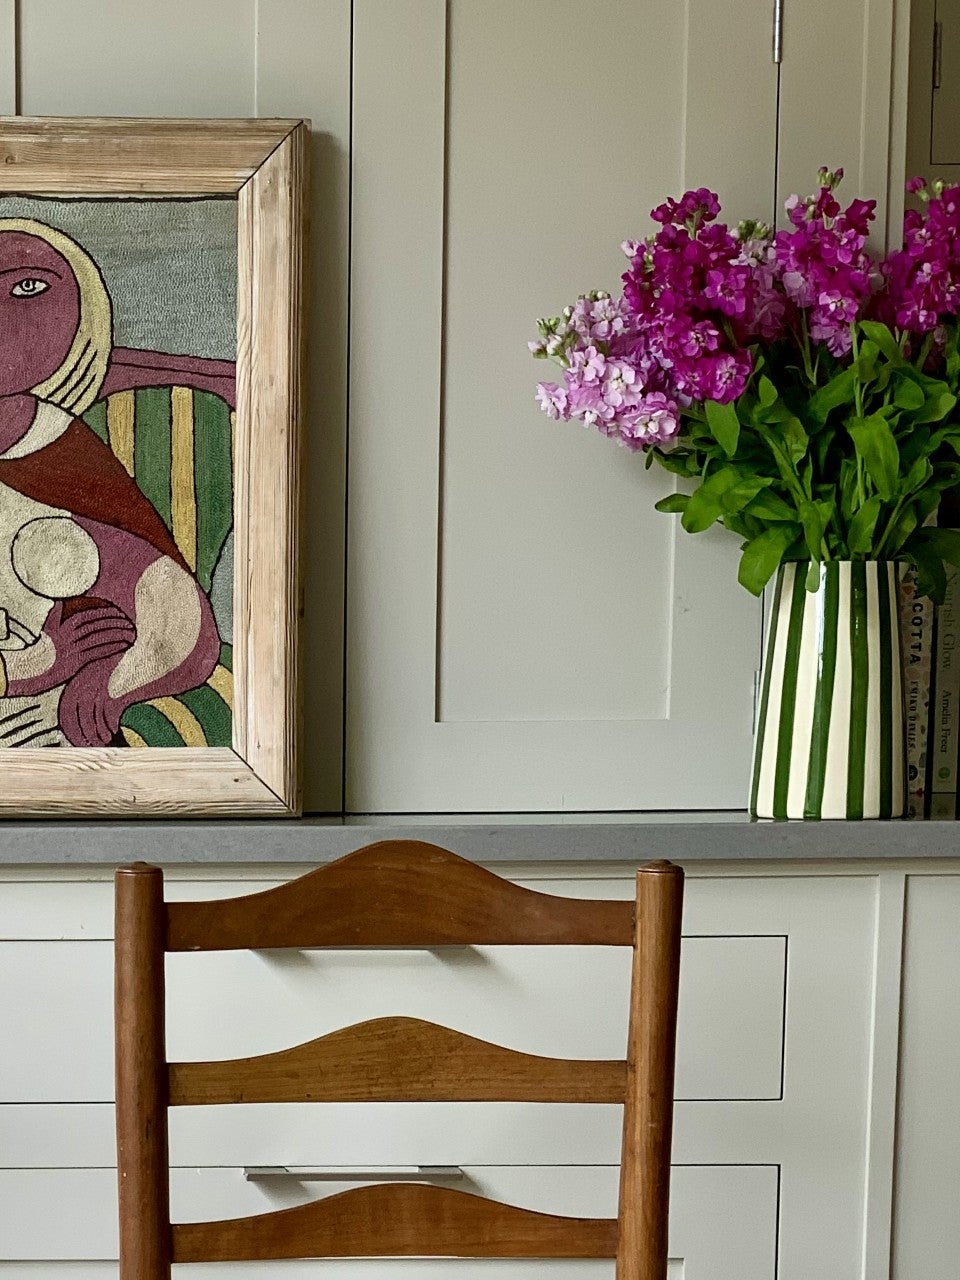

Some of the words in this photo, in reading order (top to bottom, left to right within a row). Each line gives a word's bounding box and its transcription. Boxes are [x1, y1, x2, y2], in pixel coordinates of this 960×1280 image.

[942, 633, 955, 669] Glow
[941, 690, 952, 725] Amelia
[940, 728, 951, 754] Freer
